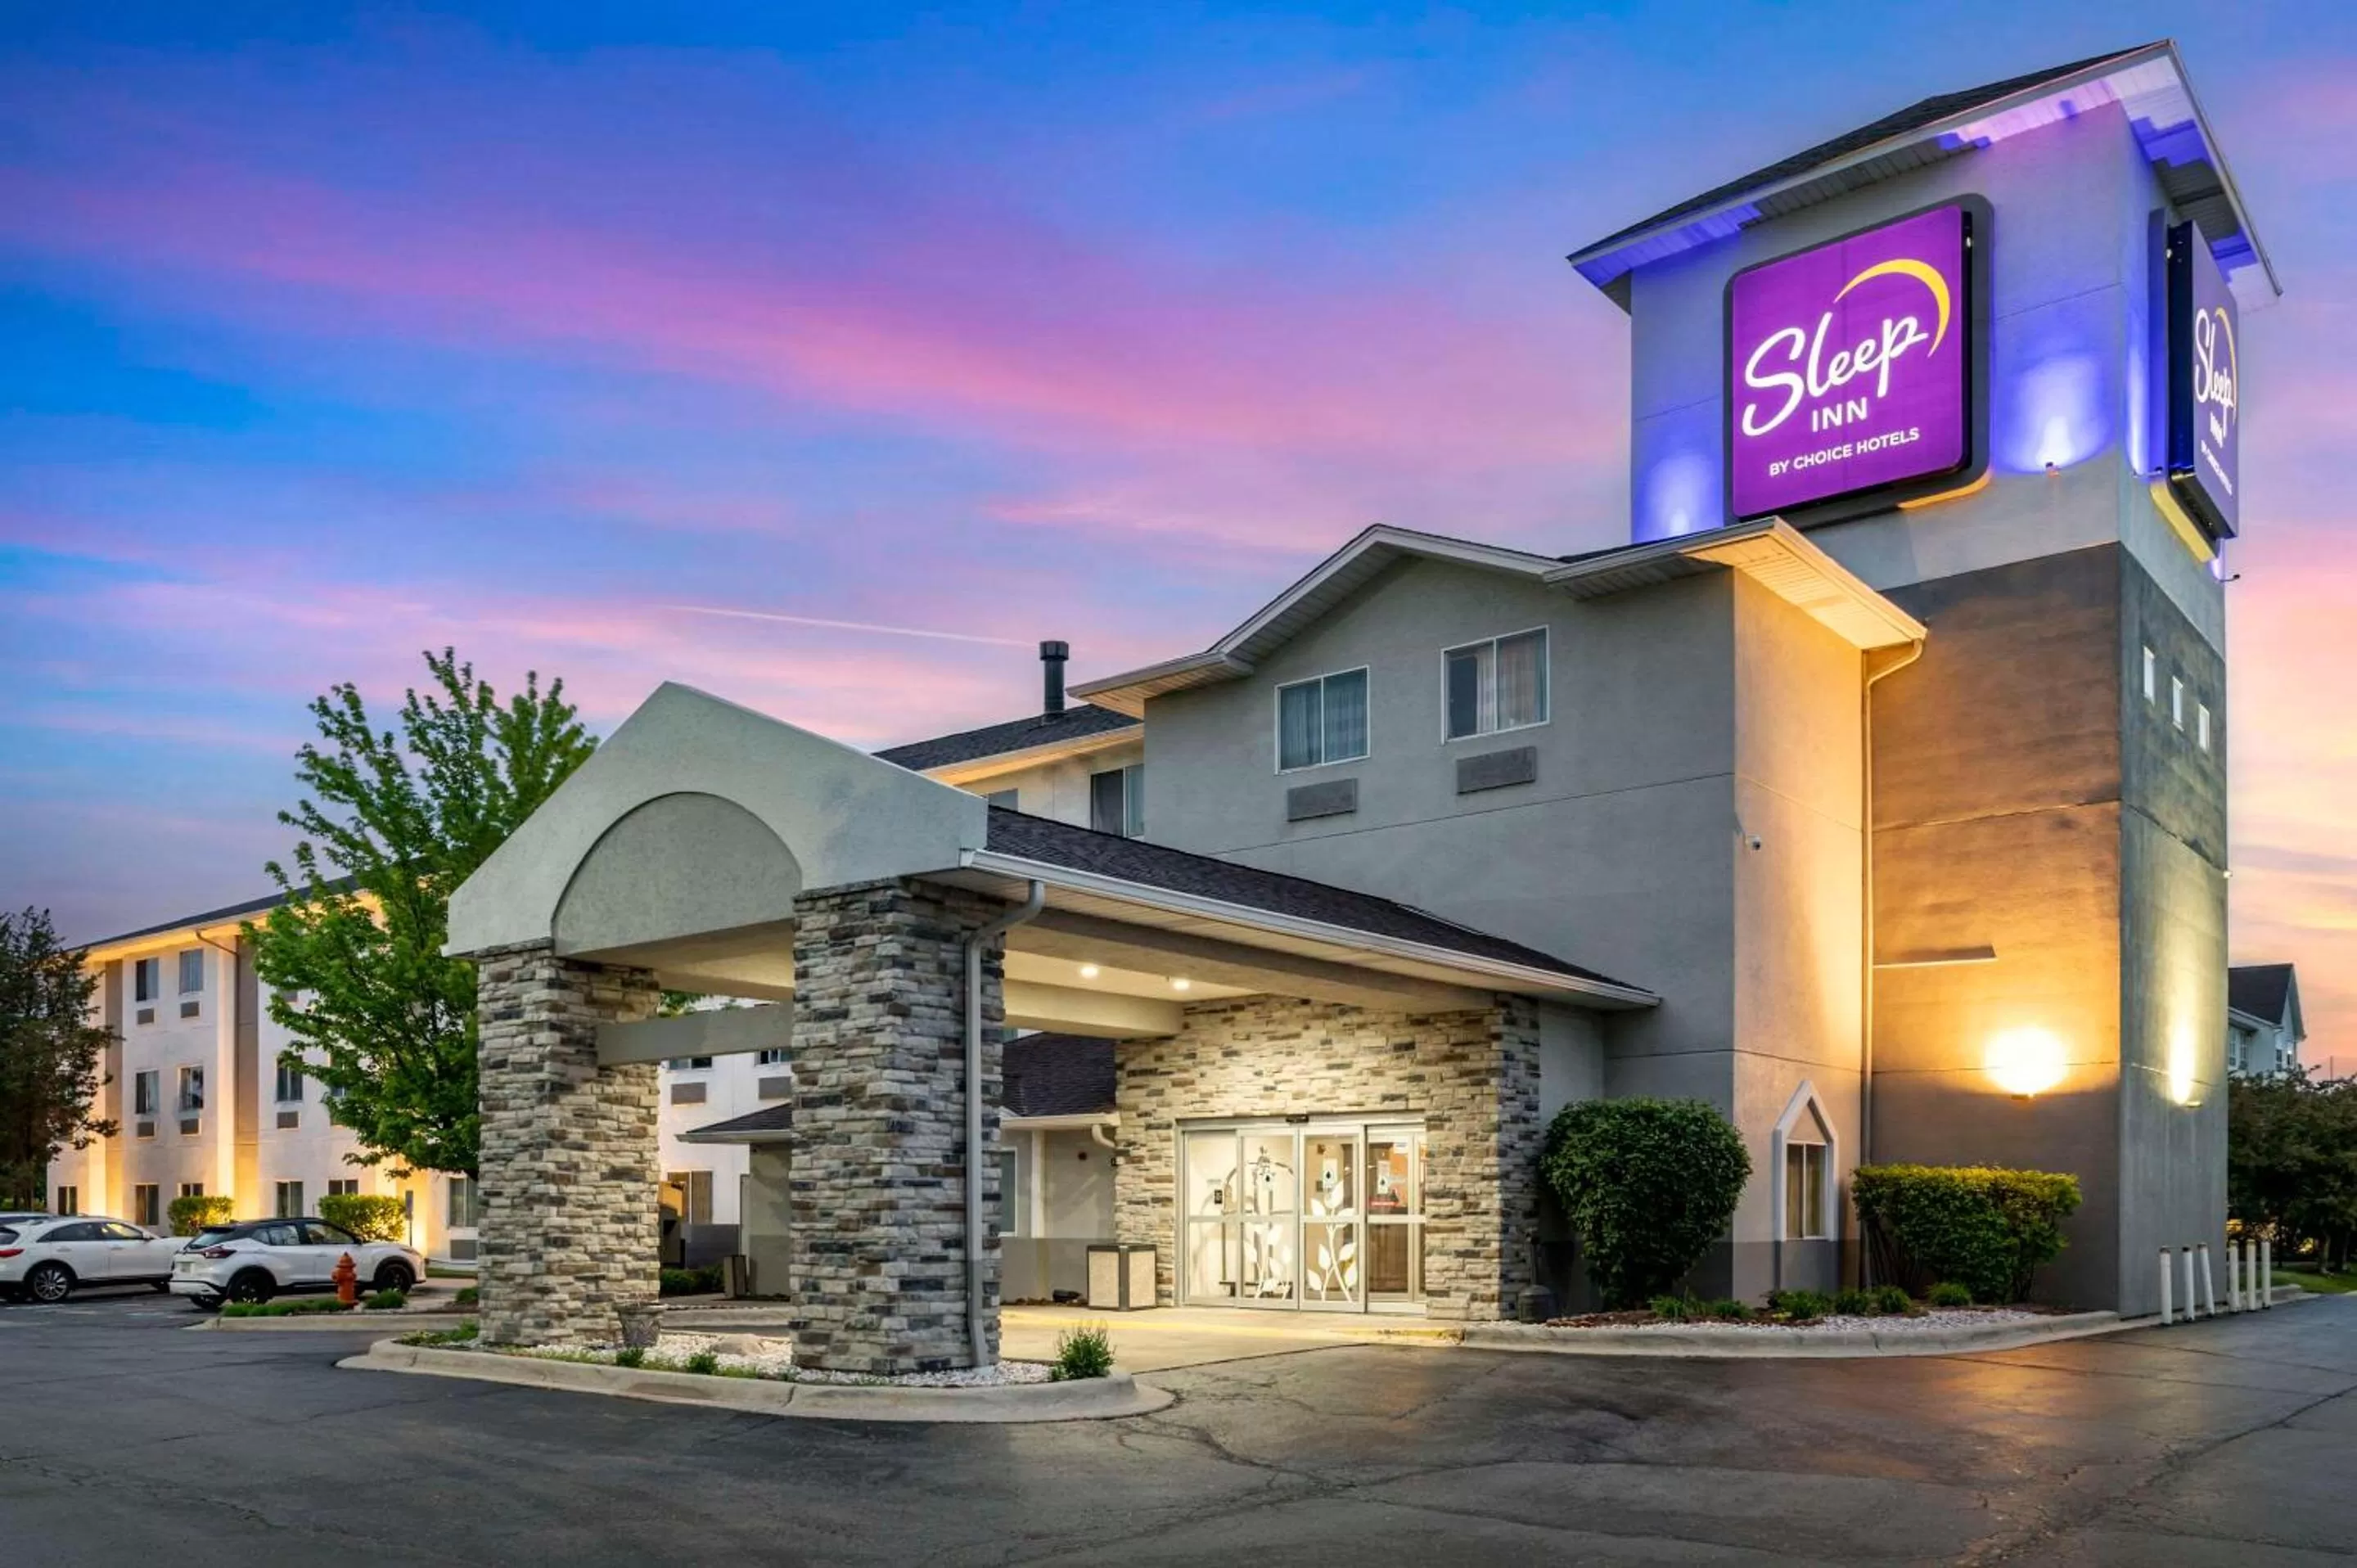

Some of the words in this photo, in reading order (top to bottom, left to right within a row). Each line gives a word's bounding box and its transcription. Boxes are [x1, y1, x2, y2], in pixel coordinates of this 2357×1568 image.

[1742, 312, 1928, 435] Sleep
[1812, 397, 1868, 432] INN
[1769, 460, 1790, 476] BY
[1793, 444, 1854, 469] CHOICE
[1856, 427, 1921, 454] HOTELS
